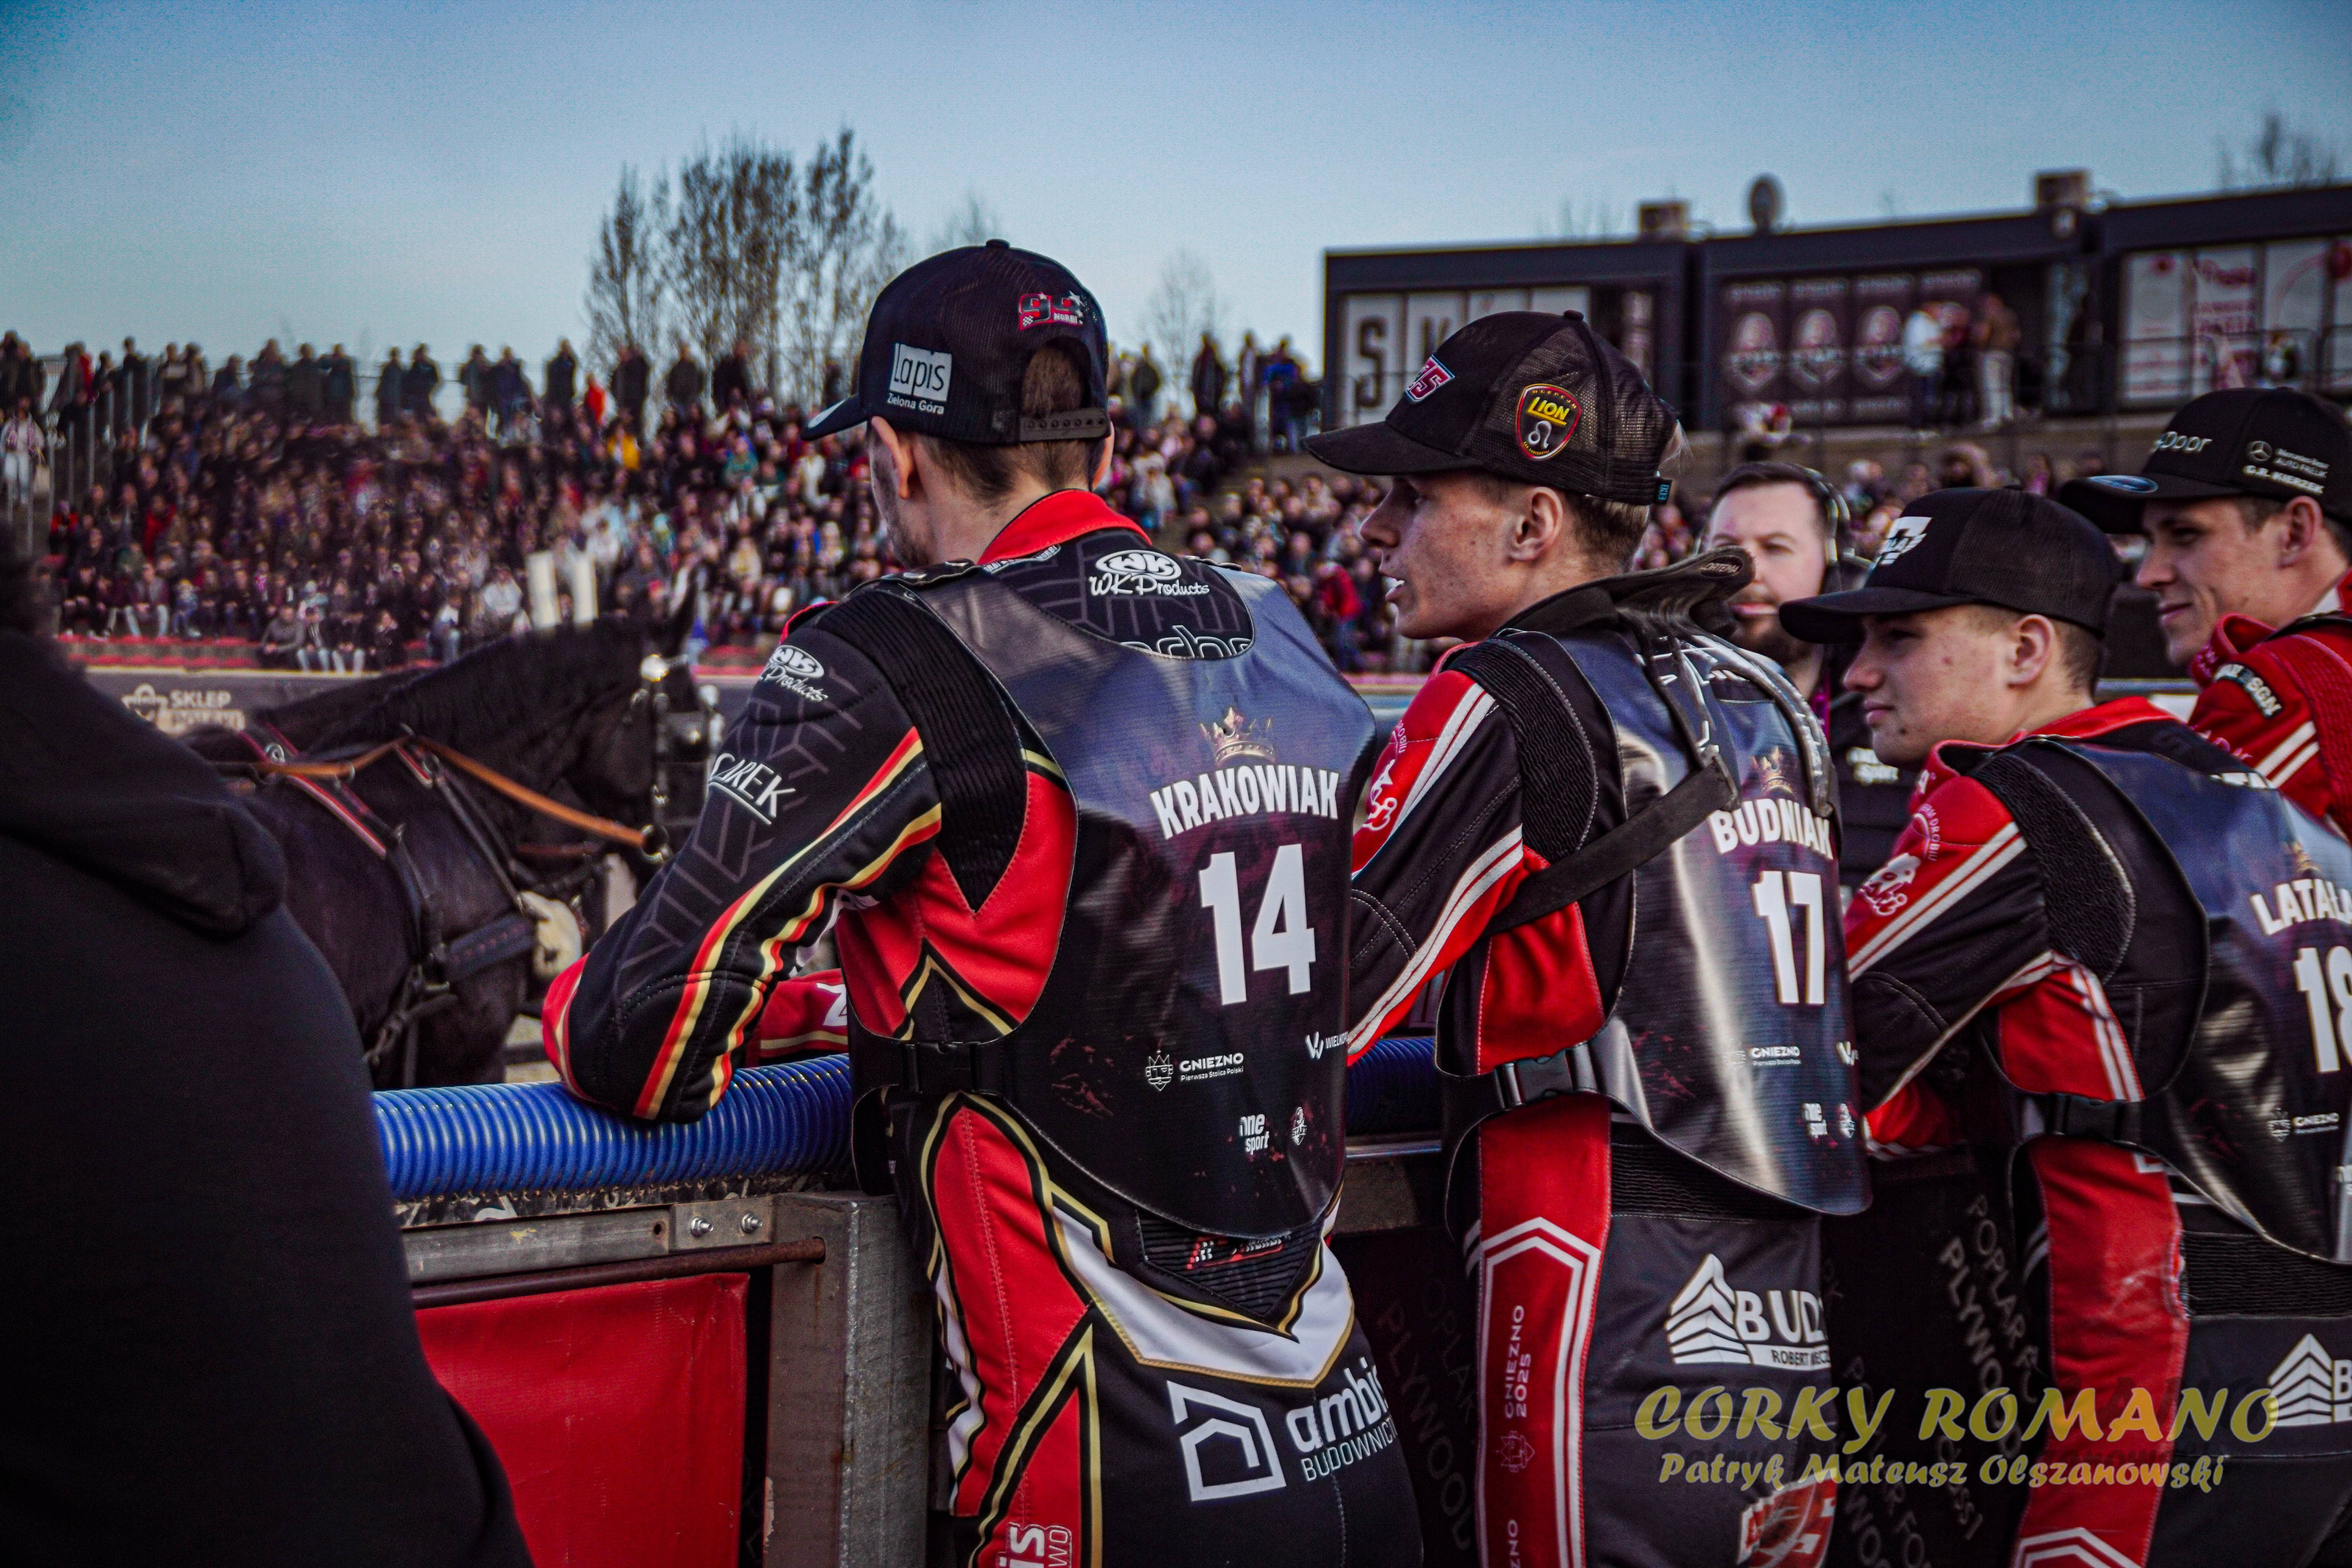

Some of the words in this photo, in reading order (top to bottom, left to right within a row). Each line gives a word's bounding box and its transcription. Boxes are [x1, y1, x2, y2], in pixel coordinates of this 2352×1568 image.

[887, 392, 916, 409] Zielona
[918, 399, 945, 415] Góra
[1528, 396, 1570, 423] LION
[1089, 572, 1133, 596] WK
[1131, 573, 1210, 596] Products
[170, 689, 232, 708] SKLEP
[1151, 765, 1339, 840] KRAKOWIAK
[1708, 798, 1834, 860] BUDNIAK
[1199, 844, 1316, 1005] 14
[1752, 870, 1825, 1004] 17
[2292, 946, 2352, 1073] 18
[1180, 1053, 1243, 1072] GNIEZNO
[1181, 1073, 1208, 1081] Pierwsza
[1209, 1069, 1226, 1078] Stolica
[1227, 1065, 1244, 1076] Polski
[1751, 1046, 1800, 1058] GNIEZNO
[1245, 1131, 1270, 1156] sport
[1734, 1290, 1828, 1343] BUD
[1504, 1305, 1525, 1419] GNIEZNO
[1514, 1353, 1532, 1418] 2025
[1286, 1356, 1389, 1453] ambi
